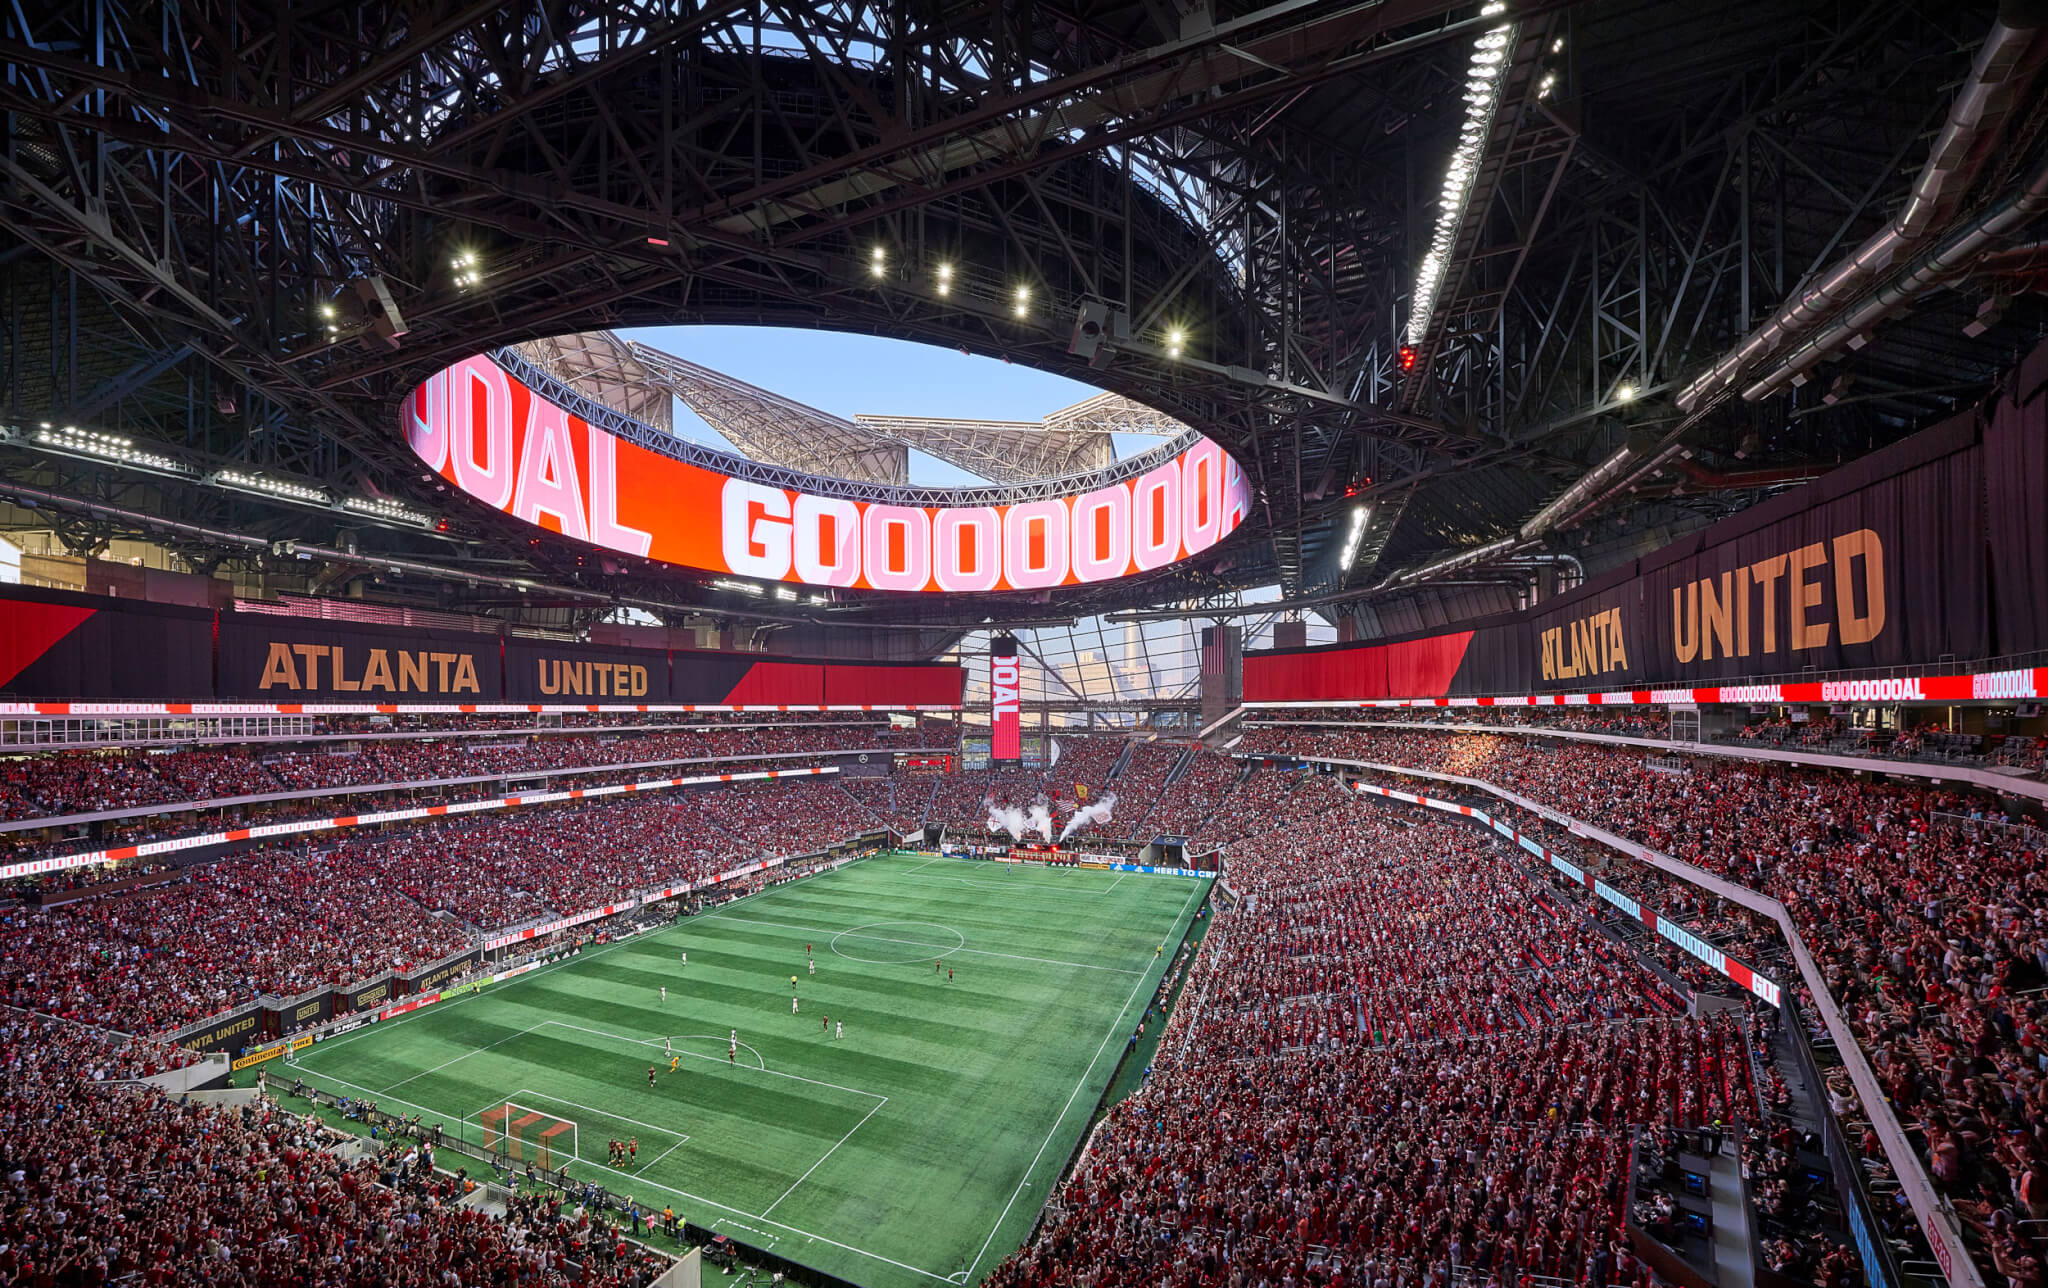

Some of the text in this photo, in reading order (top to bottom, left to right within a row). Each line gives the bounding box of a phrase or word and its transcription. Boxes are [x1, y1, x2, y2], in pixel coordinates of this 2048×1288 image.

[1541, 528, 1886, 681] ATLANTA UNITED
[259, 642, 648, 697] ATLANTA UNITED
[1719, 684, 1784, 702] GOOOOOOOAL
[1822, 678, 1926, 701] GOOOOOOOAL
[1153, 866, 1178, 876] HERE
[1182, 869, 1196, 877] TO
[421, 970, 449, 989] ATLANTA
[450, 959, 472, 975] UNITED
[216, 1017, 255, 1040] UNITED
[235, 1038, 311, 1069] Continental TIRE
